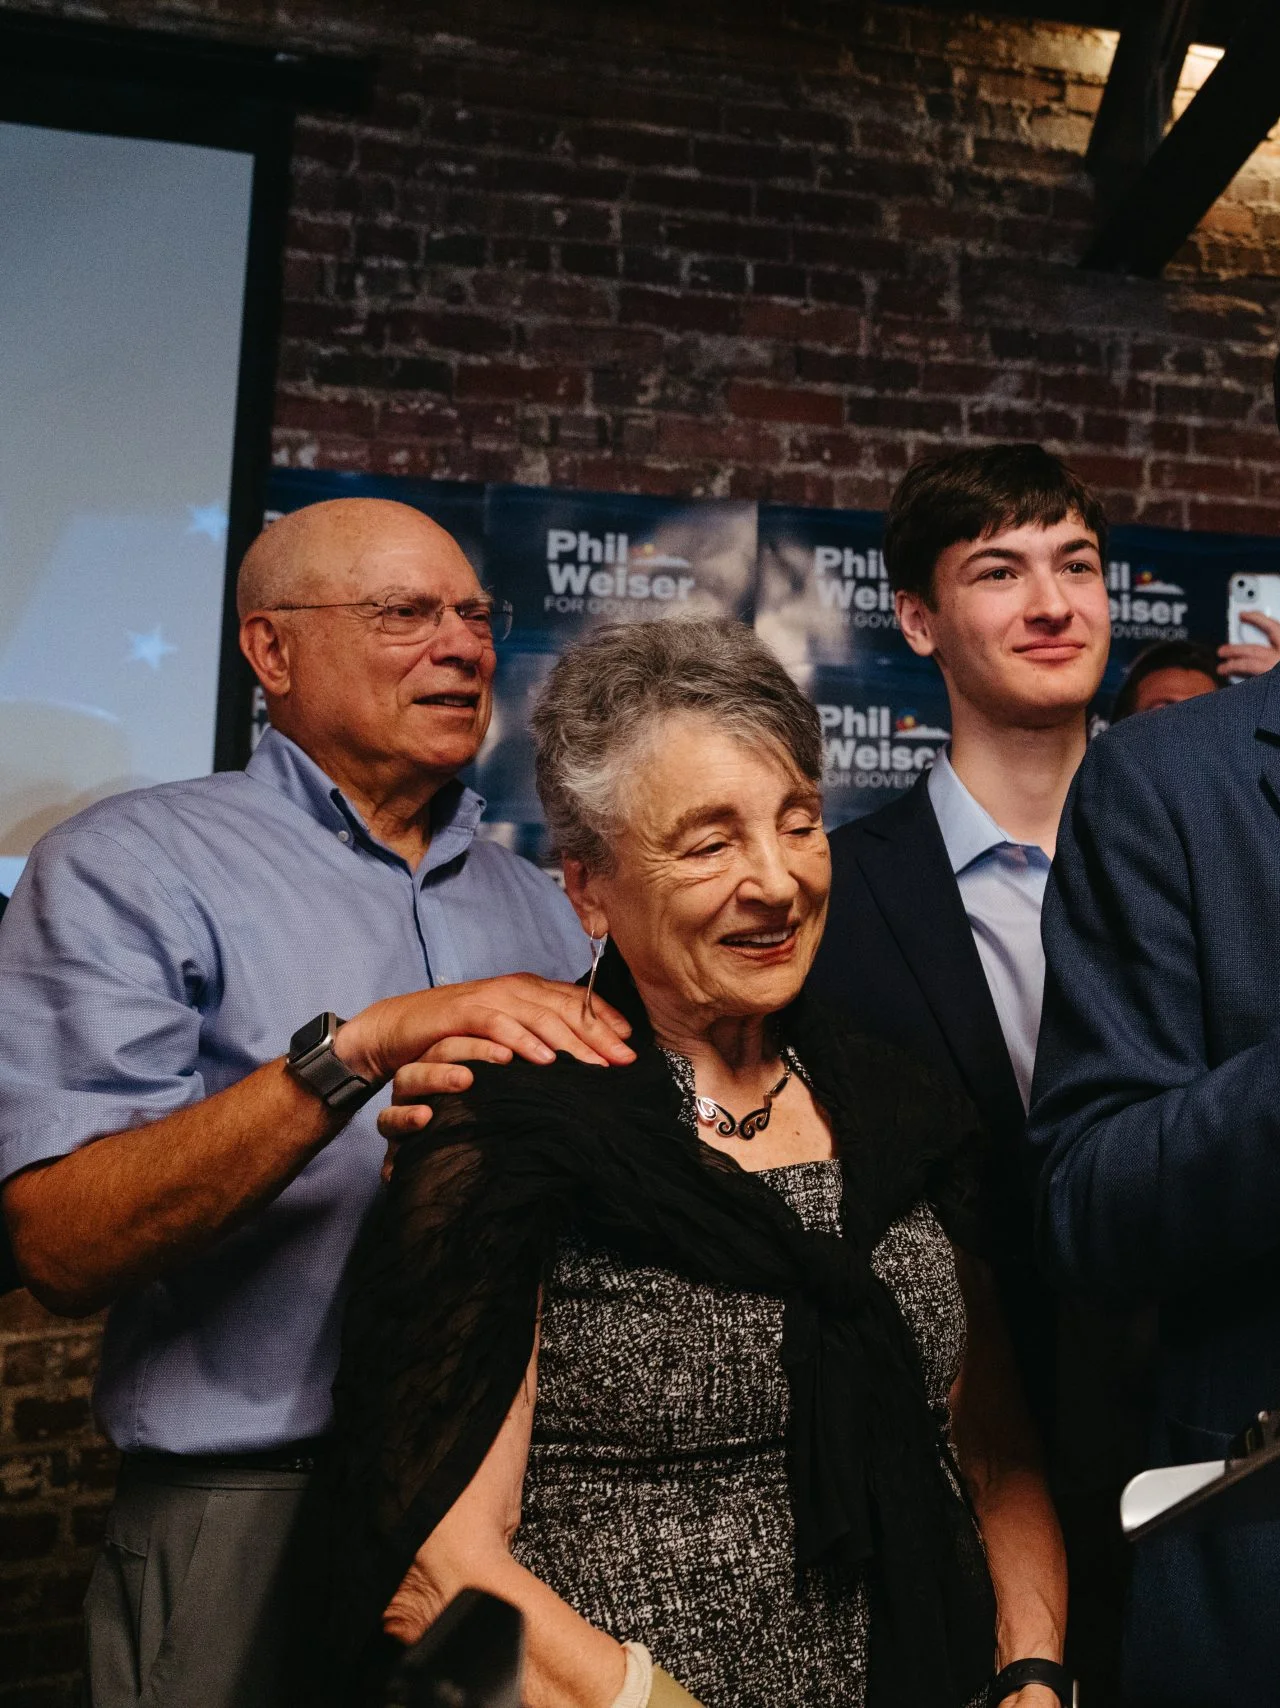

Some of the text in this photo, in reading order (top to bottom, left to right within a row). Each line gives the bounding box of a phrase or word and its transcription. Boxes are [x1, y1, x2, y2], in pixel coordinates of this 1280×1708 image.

[547, 529, 628, 563] Phil
[815, 546, 888, 579] Phil
[548, 563, 695, 600] Weiser
[816, 580, 896, 612] Wei
[544, 595, 585, 614] FOR
[1109, 593, 1188, 625] eiser
[1111, 622, 1188, 641] OVERNOR
[817, 704, 890, 738] Phil
[821, 738, 936, 771] Weise
[821, 770, 852, 789] OR
